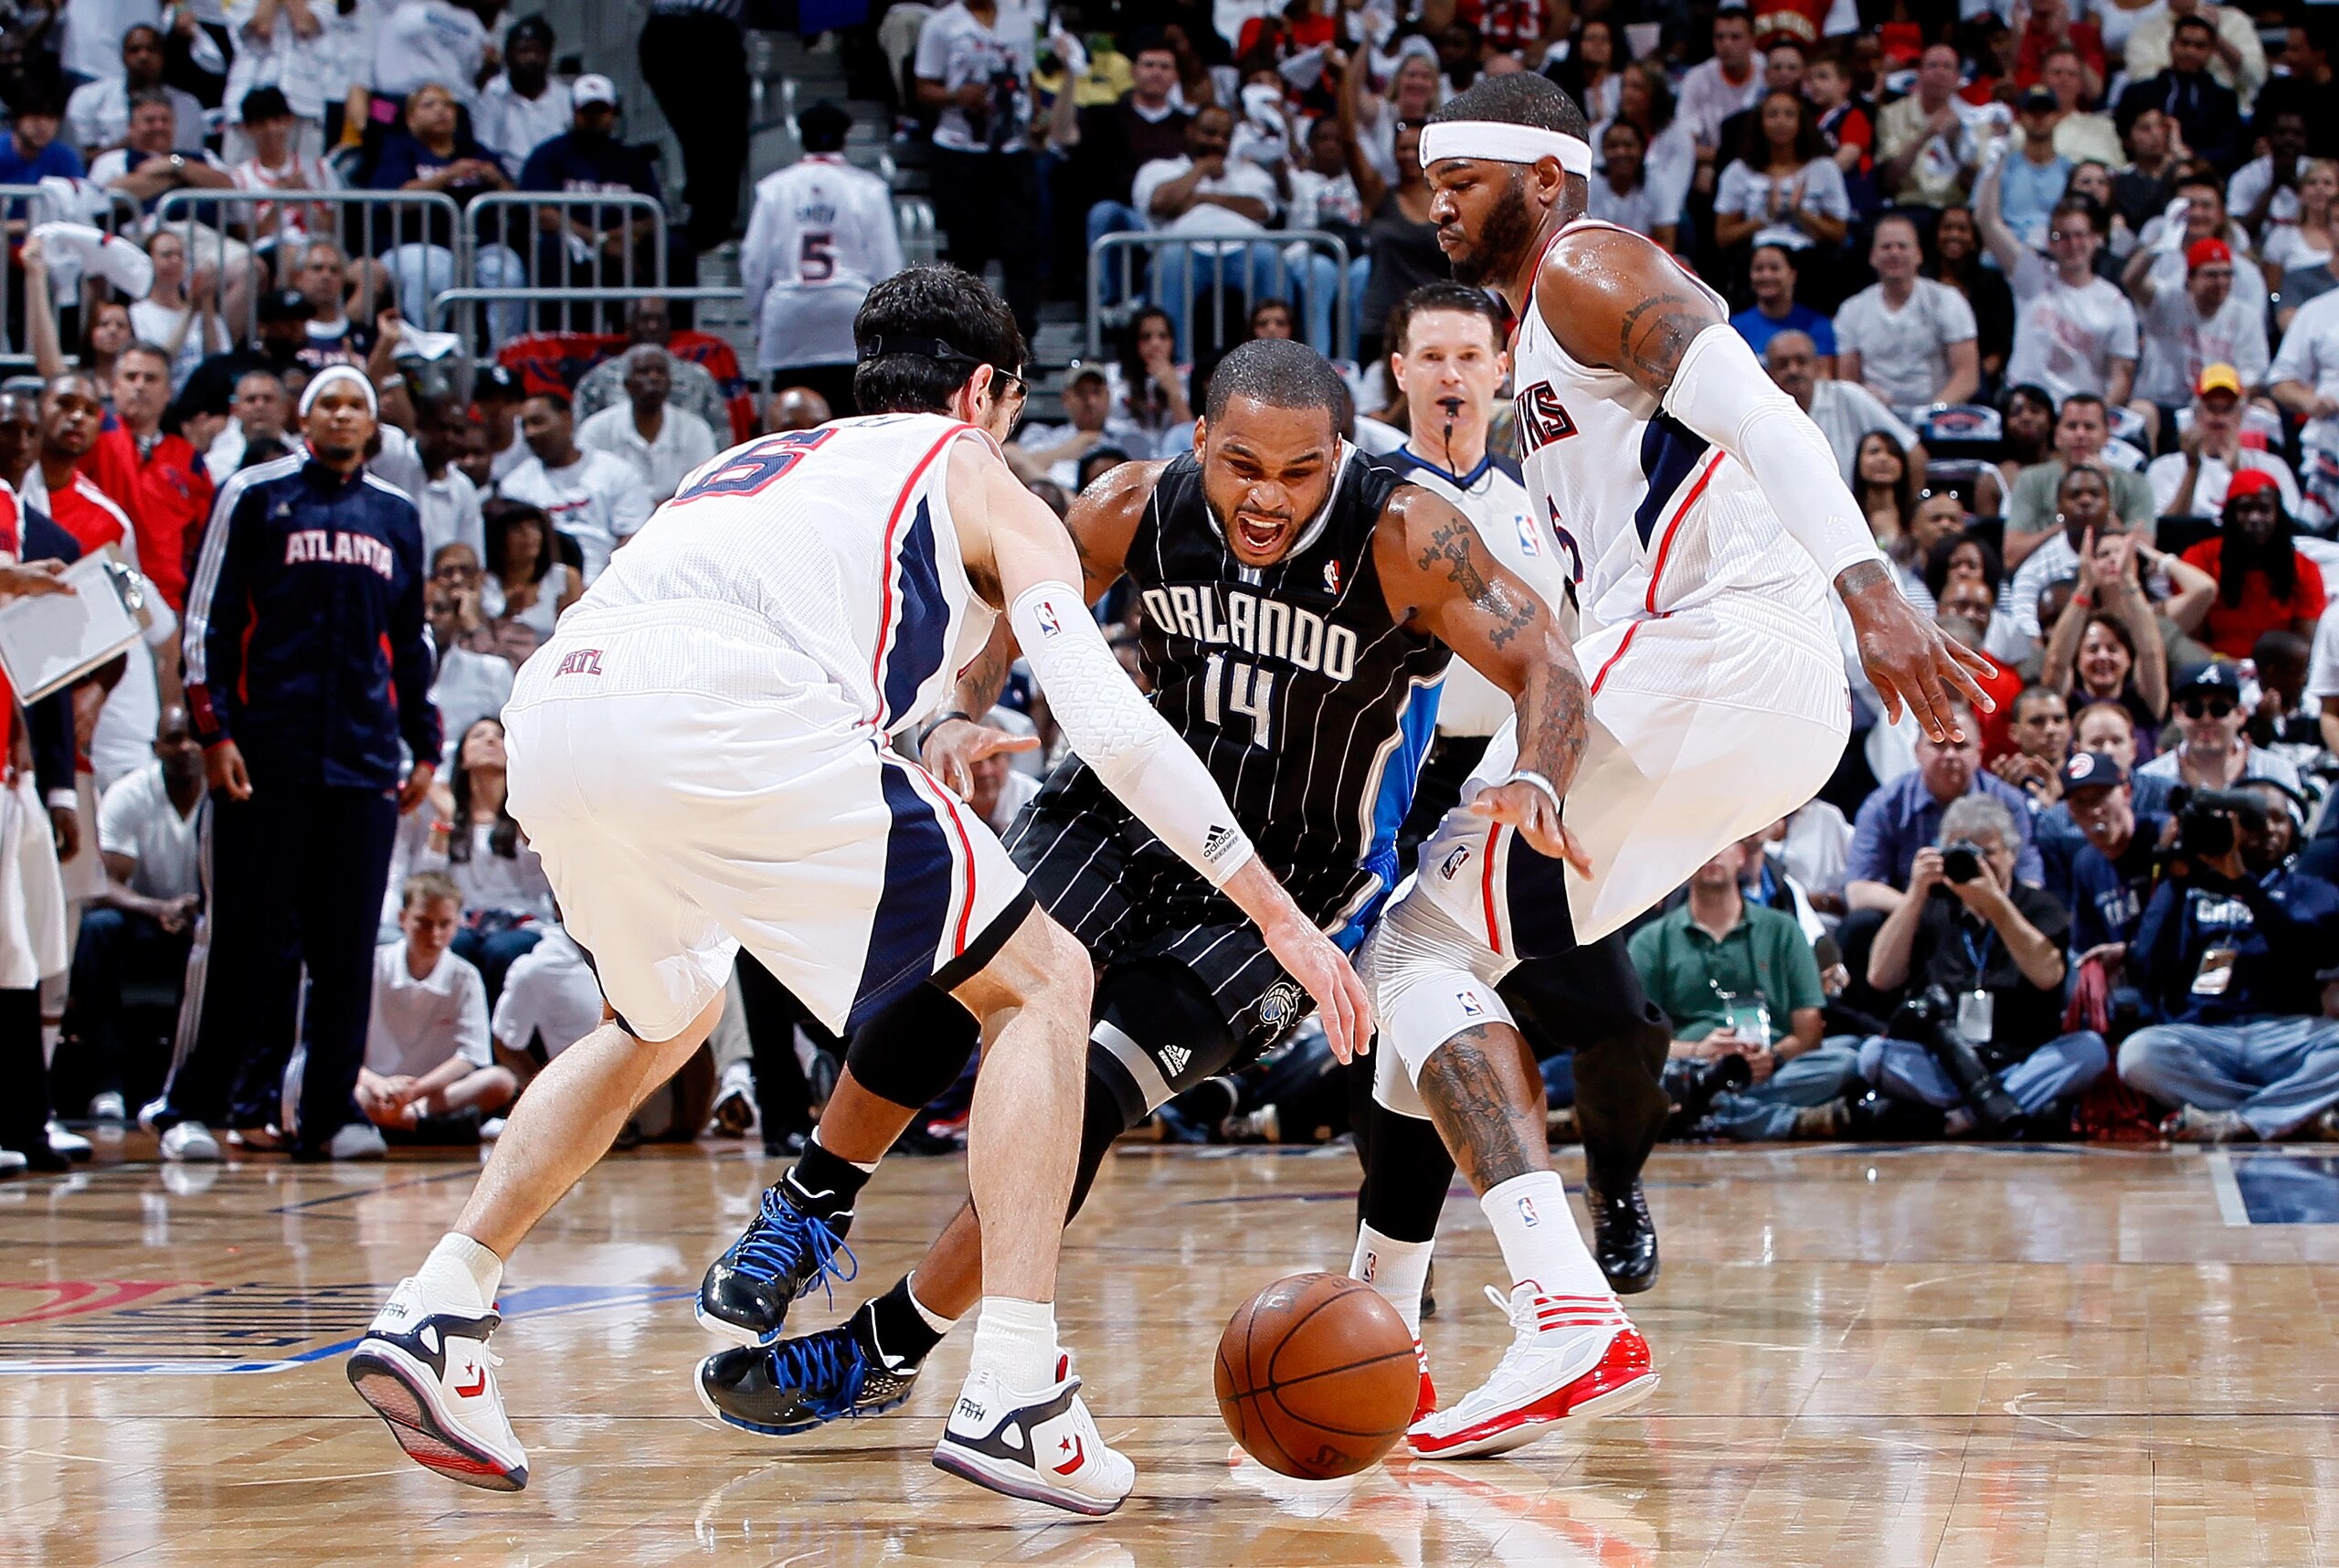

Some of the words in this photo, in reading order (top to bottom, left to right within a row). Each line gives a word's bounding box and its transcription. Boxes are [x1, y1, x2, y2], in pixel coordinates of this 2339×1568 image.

[800, 231, 835, 281] 5
[667, 427, 840, 508] 6
[283, 529, 393, 580] ATLANTA
[1142, 586, 1358, 683] ORLANDO
[553, 649, 603, 679] ATL
[2196, 663, 2221, 684] A
[1203, 652, 1275, 750] 14
[1203, 828, 1234, 858] adidas
[1164, 1044, 1185, 1073] adidas
